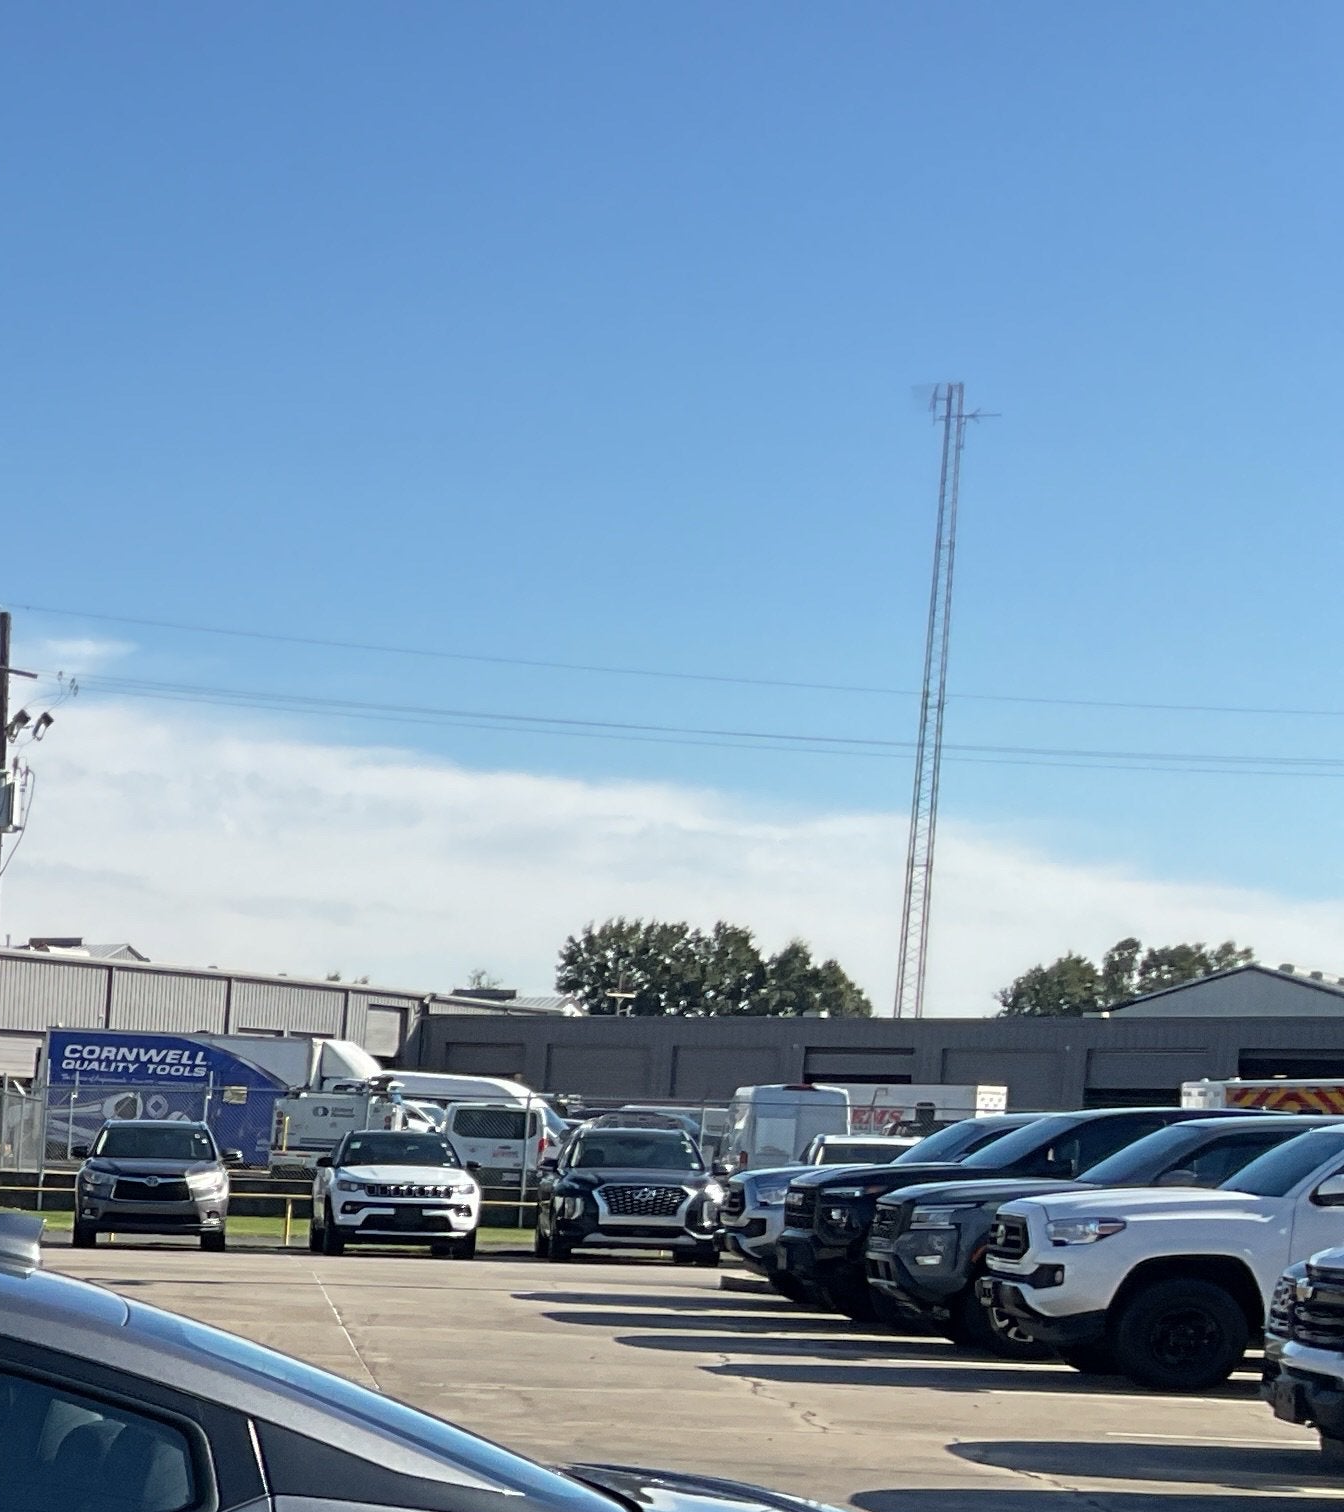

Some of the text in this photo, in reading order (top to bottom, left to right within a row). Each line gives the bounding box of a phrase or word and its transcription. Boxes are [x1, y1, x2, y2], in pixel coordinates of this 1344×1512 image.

[64, 1044, 207, 1065] CORNWELL
[61, 1059, 207, 1077] QUALITY TOOLS
